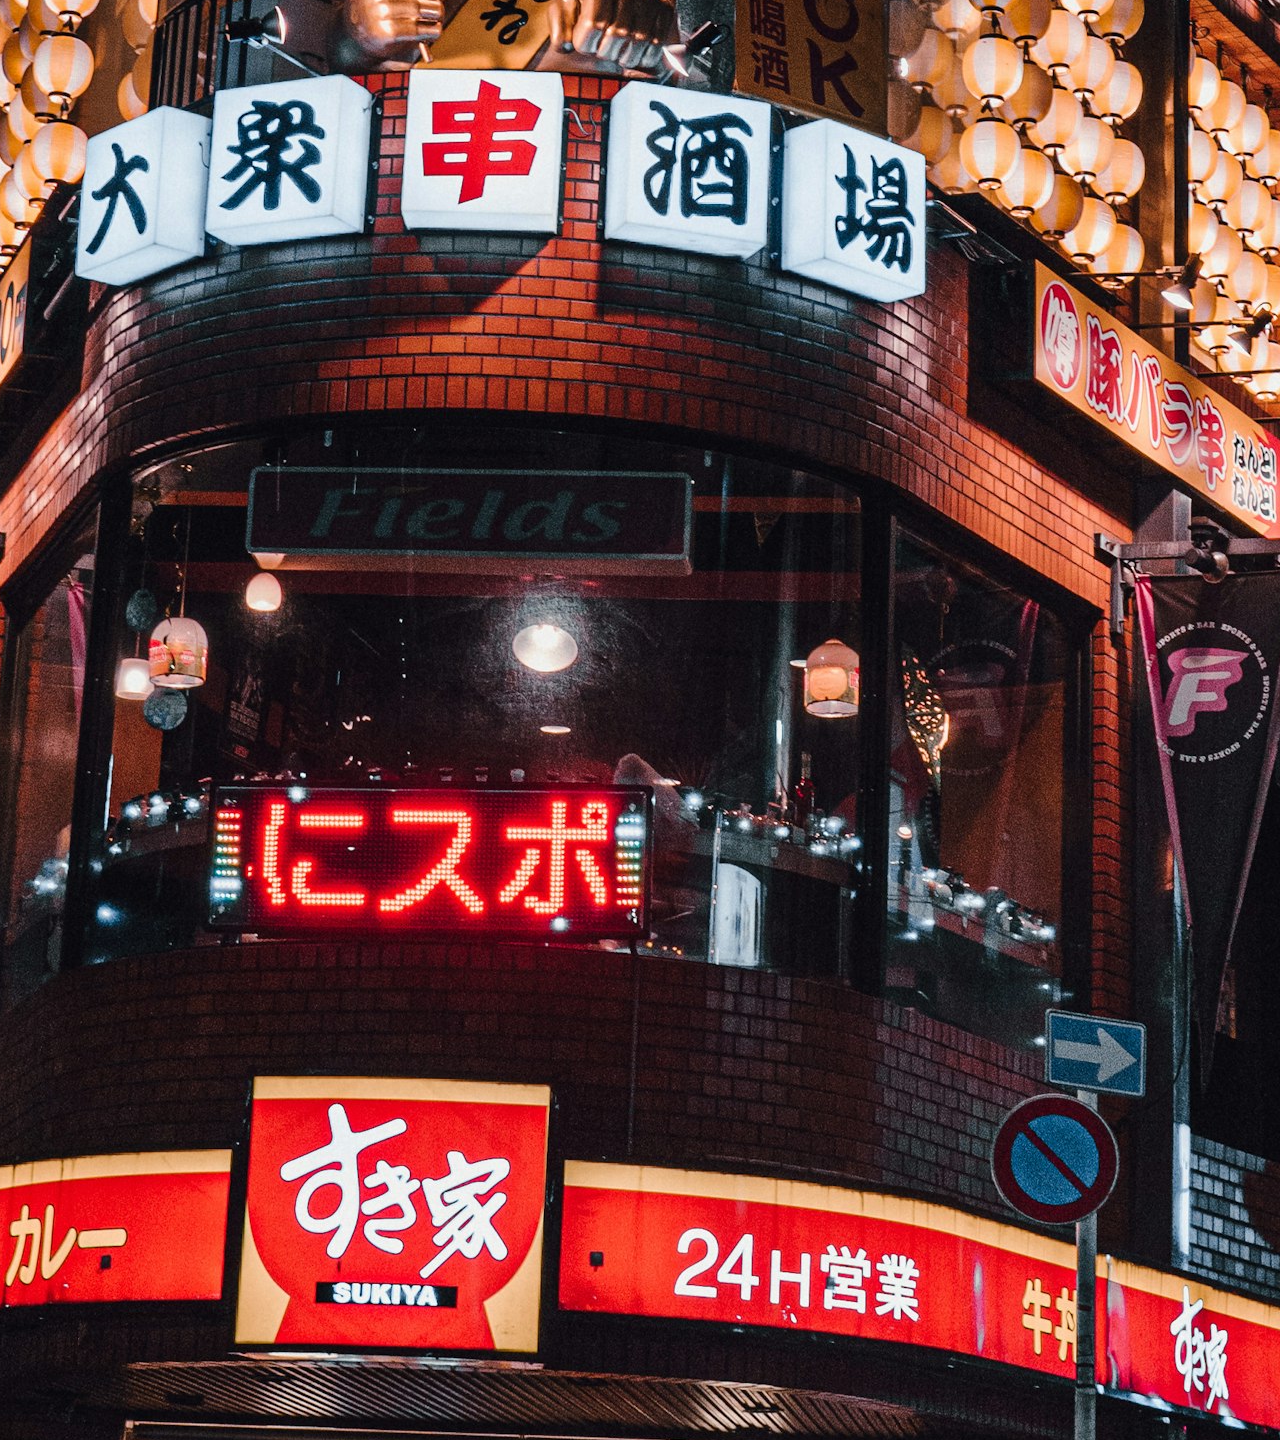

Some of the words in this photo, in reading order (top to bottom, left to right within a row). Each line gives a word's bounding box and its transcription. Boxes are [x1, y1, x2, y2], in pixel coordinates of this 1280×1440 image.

[1085, 312, 1228, 491] 豚バラ串
[309, 486, 629, 543] Fields
[244, 798, 614, 916] にスポ
[279, 1101, 512, 1281] すき家
[5, 1204, 129, 1287] カレー
[332, 1281, 439, 1308] SUKIYA
[672, 1226, 922, 1322] 24H営業
[1020, 1277, 1078, 1363] 牛丼
[1170, 1284, 1231, 1411] すき家
